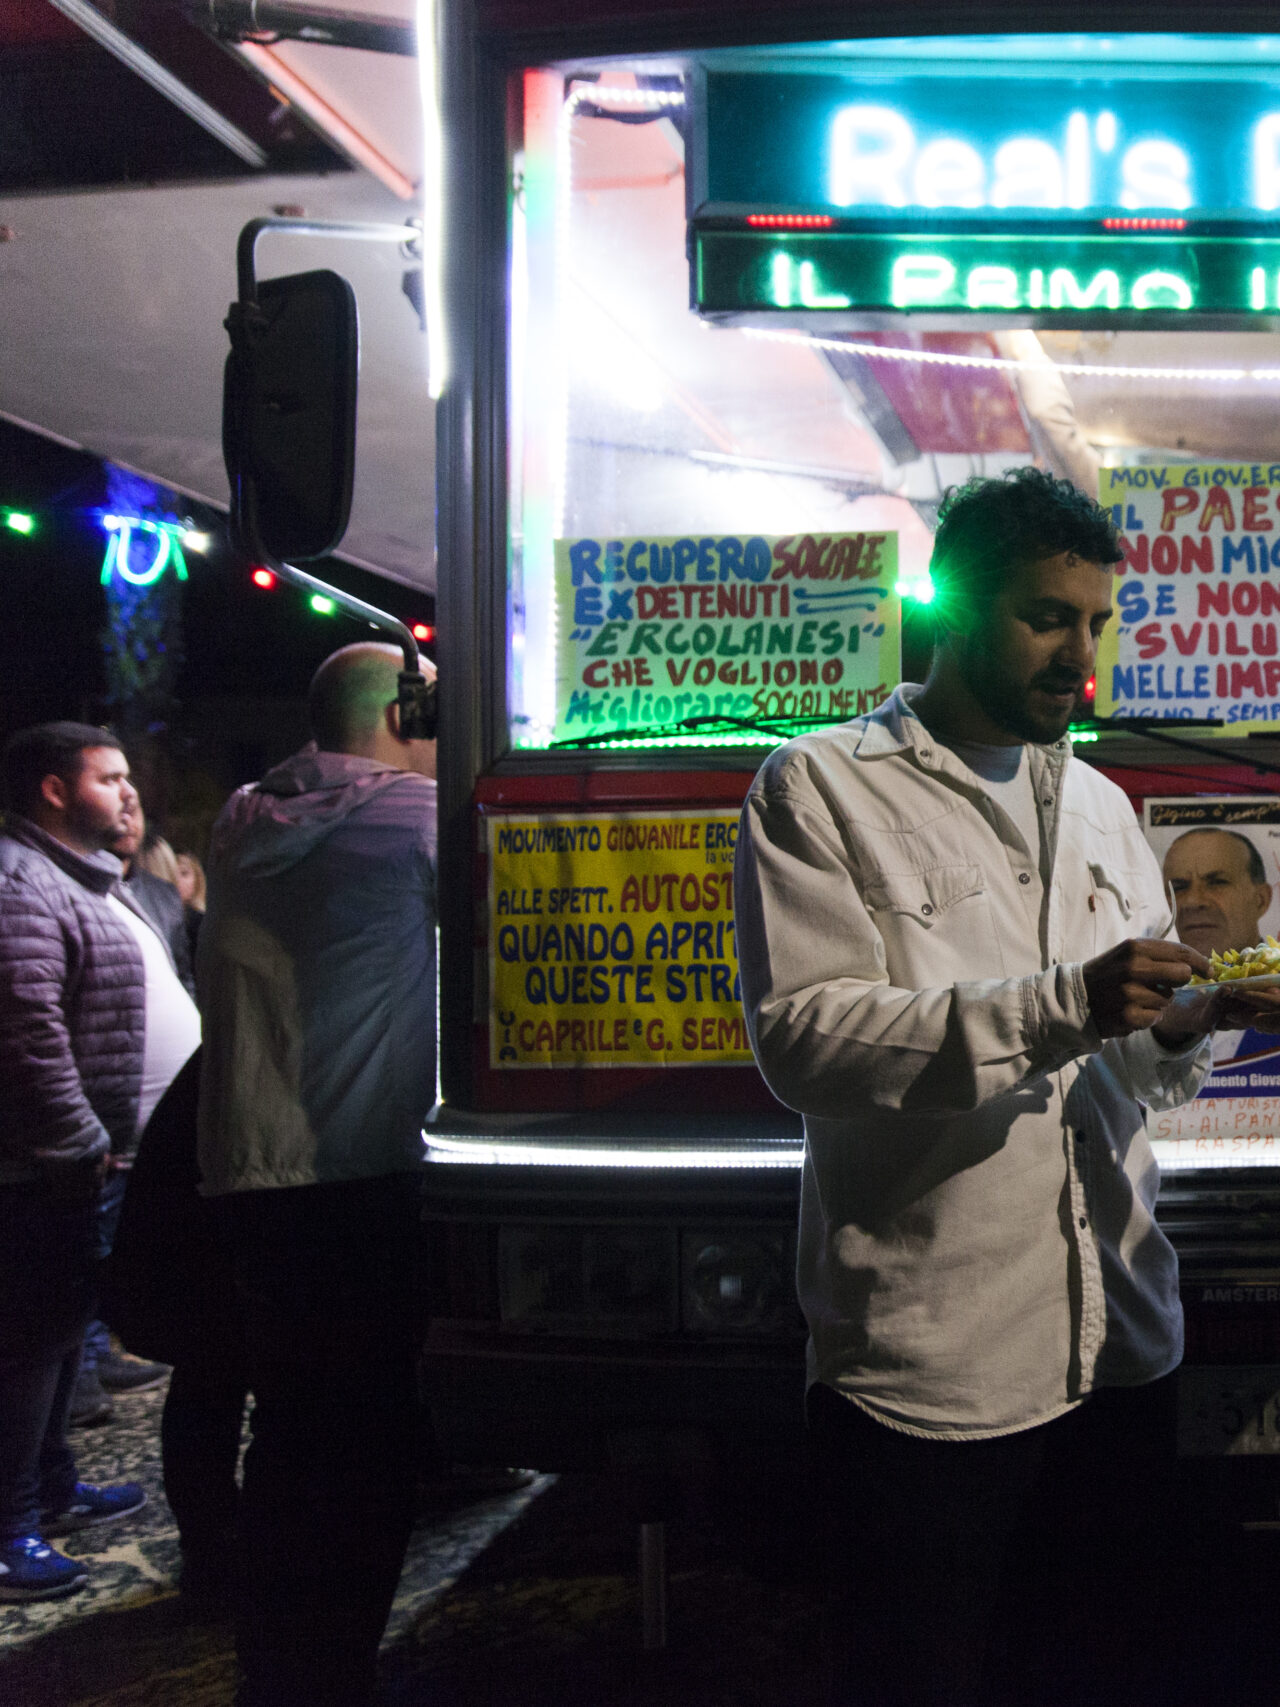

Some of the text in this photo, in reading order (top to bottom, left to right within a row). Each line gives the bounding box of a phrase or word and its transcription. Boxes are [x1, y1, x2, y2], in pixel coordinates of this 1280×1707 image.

[827, 104, 1192, 210] Real's
[769, 252, 849, 309] IL
[1110, 468, 1171, 488] MOV.
[1112, 503, 1144, 531] IL
[569, 533, 886, 587] RECUPERO SOCIALE
[1115, 533, 1215, 576] NON
[575, 584, 790, 625] EX DETENUTI
[1117, 580, 1177, 623] SE
[582, 657, 843, 688] CHE VOGLIONO
[1111, 664, 1210, 701] NELLE
[498, 826, 600, 853] MOVIMENTO
[607, 824, 699, 851] GIOVANILE
[497, 888, 542, 914] ALLE
[548, 887, 613, 913] SPETT.
[499, 922, 634, 963] QUANDO
[525, 965, 655, 1005] QUESTE
[519, 1018, 628, 1050] CAPRILE
[646, 1018, 673, 1050] G.
[682, 1016, 750, 1050] SEM
[1205, 1073, 1247, 1087] mento
